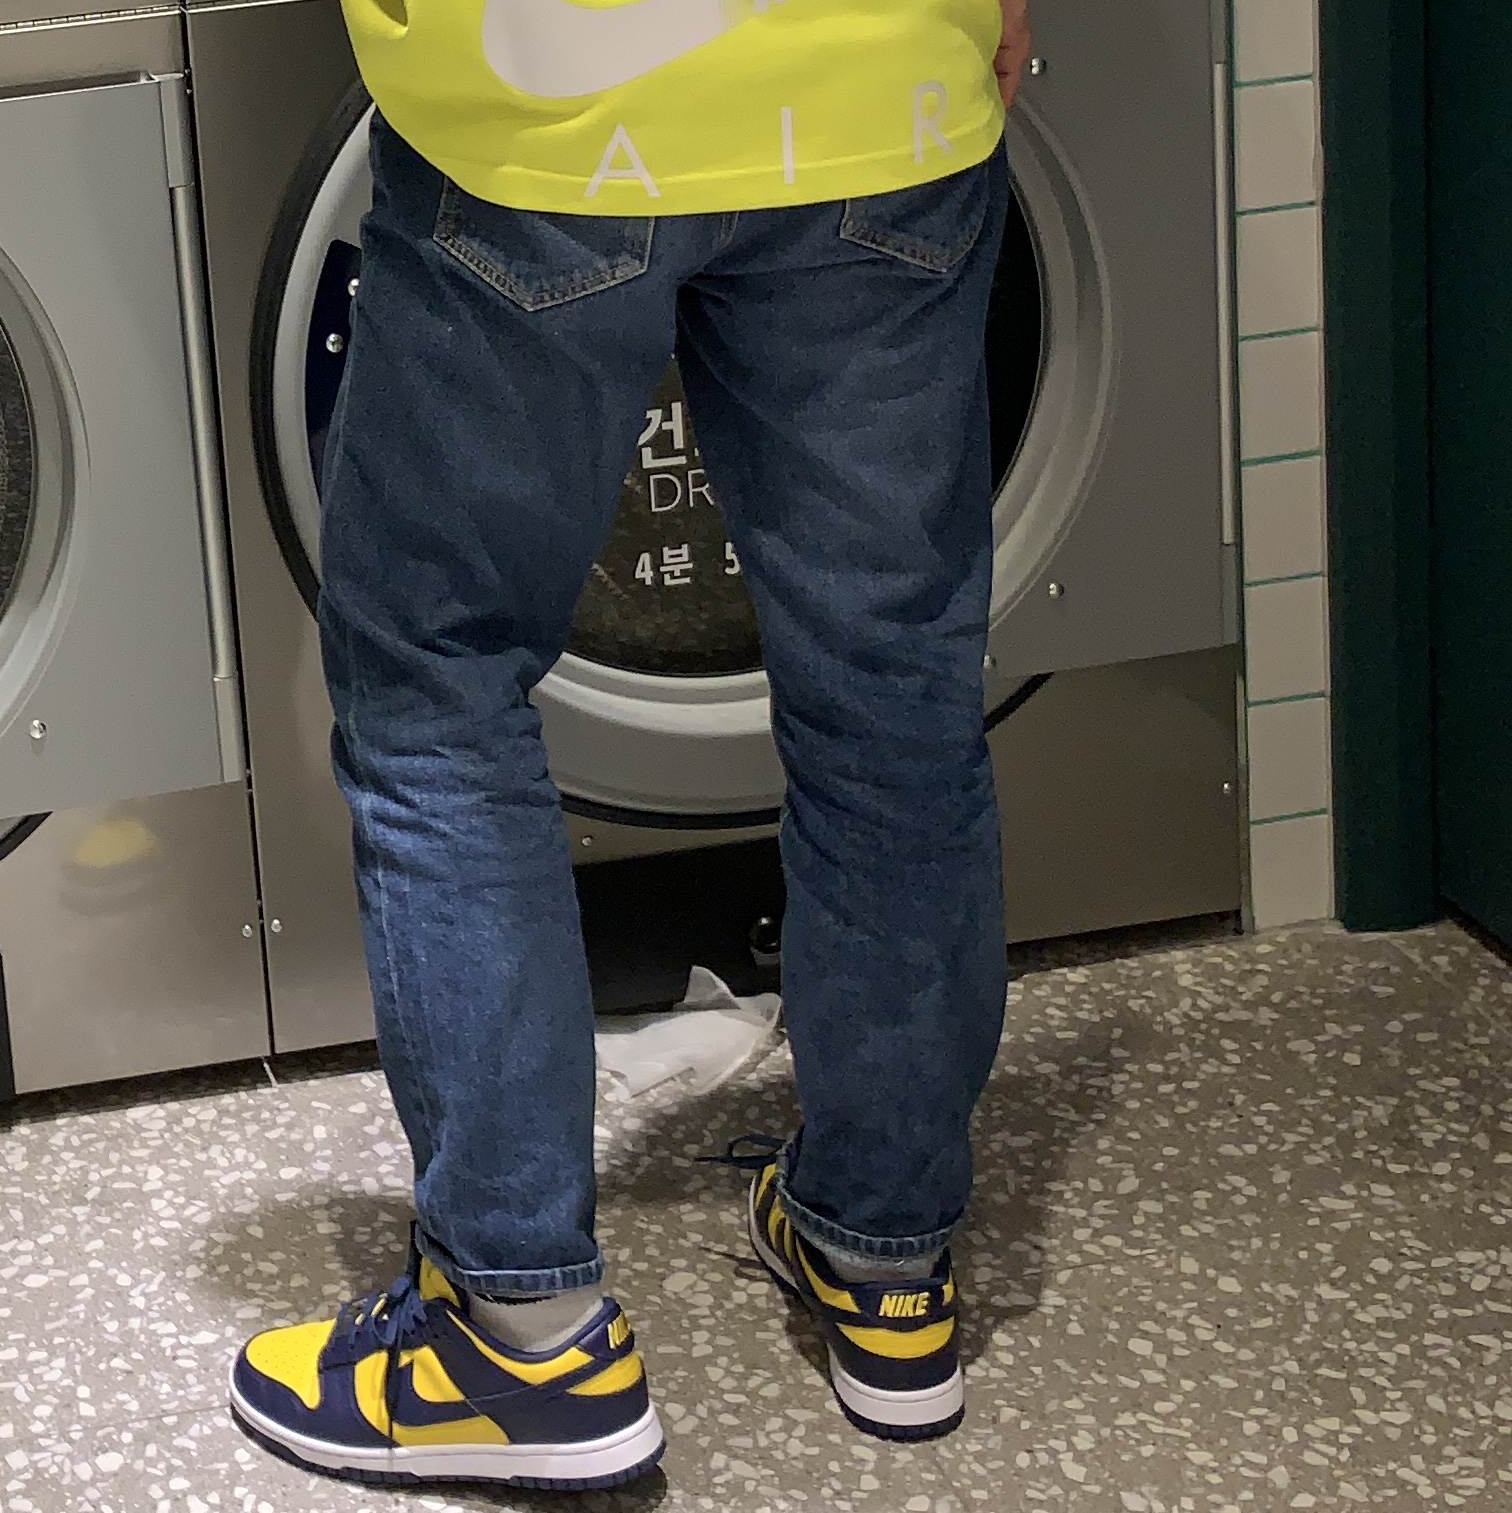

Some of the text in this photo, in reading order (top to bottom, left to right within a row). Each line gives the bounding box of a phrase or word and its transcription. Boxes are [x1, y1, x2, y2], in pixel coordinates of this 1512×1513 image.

[584, 79, 953, 198] AIR
[638, 401, 699, 469] 건
[649, 468, 714, 512] DR
[635, 541, 740, 586] 4분 5
[878, 1291, 929, 1318] NIKE
